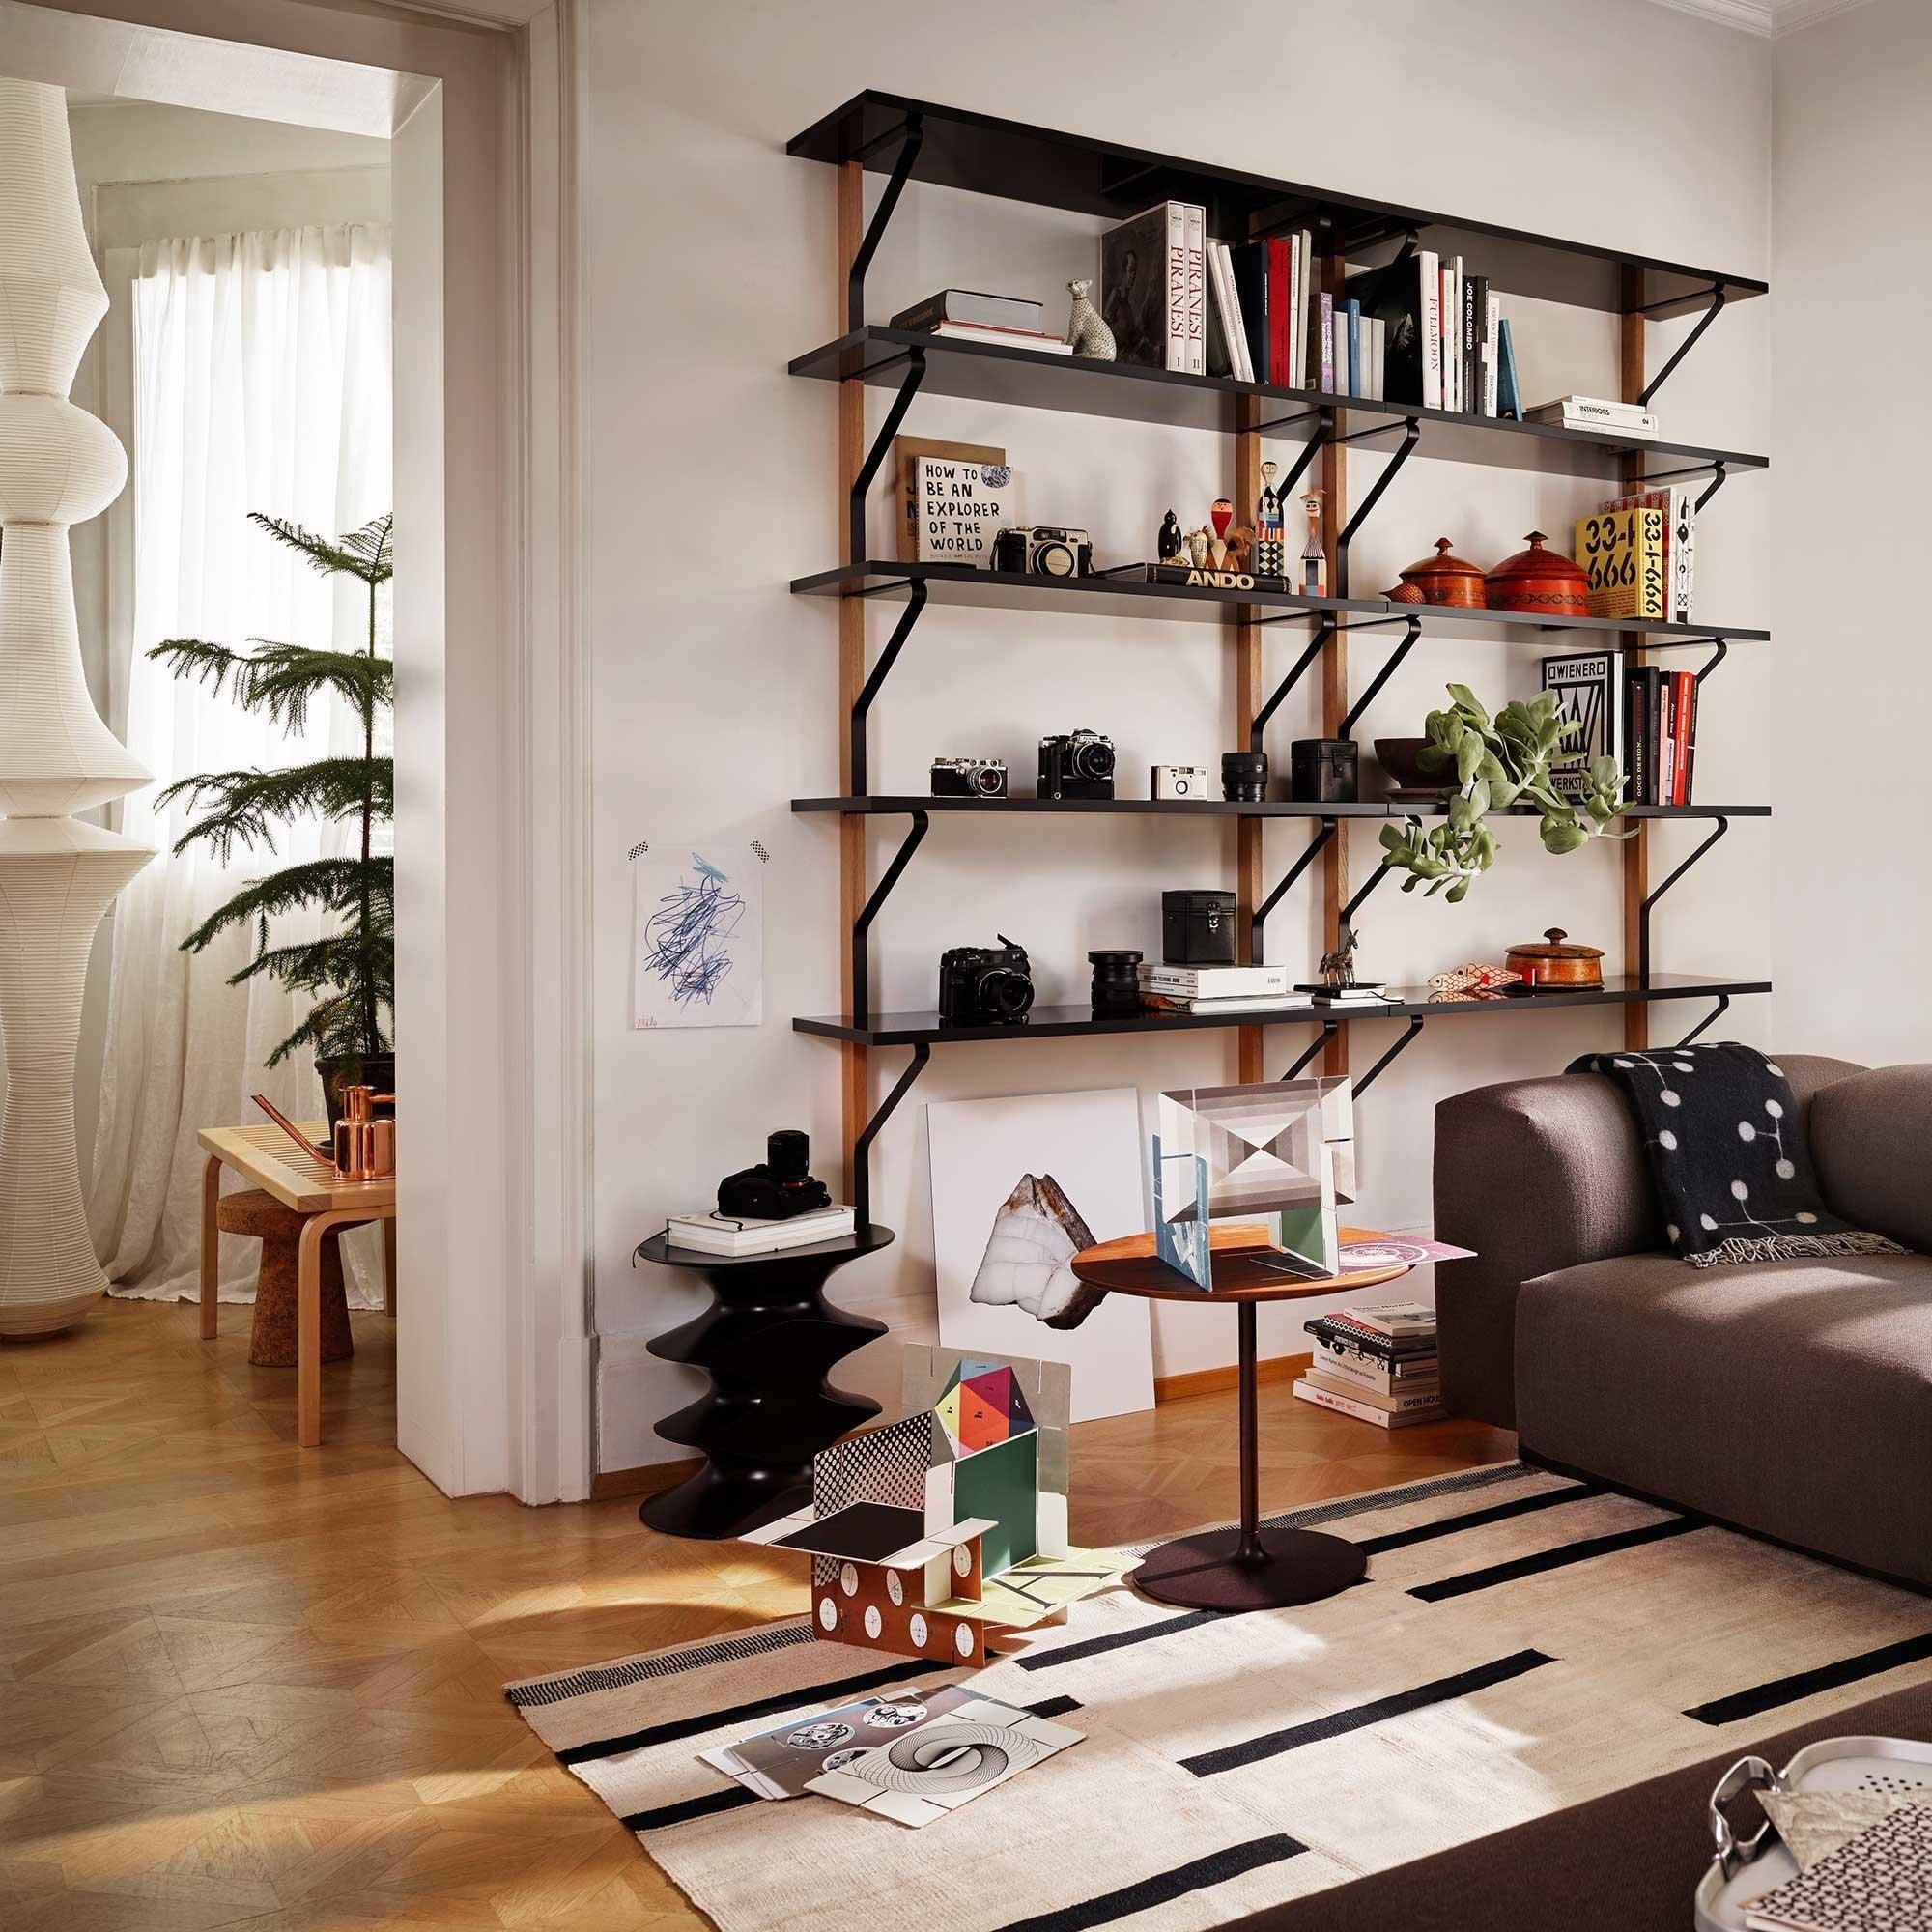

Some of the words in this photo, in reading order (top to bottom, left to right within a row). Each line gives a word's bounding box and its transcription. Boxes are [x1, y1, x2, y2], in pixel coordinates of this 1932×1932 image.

[1170, 245, 1183, 339] PIRANESI
[1189, 247, 1202, 341] PIRANESI
[1430, 298, 1438, 372] FULLMOON
[1579, 406, 1610, 415] INTERIORS
[926, 465, 954, 479] HOW
[963, 469, 978, 480] TO
[927, 482, 944, 496] BE
[952, 484, 972, 497] AN
[927, 502, 1000, 517] EXPLORER
[929, 522, 946, 534] OF
[953, 522, 981, 535] THE
[930, 538, 983, 551] WORLD
[1585, 552, 1636, 591] 666
[1186, 570, 1254, 590] ANDO
[1404, 1397, 1422, 1408] OPEN
